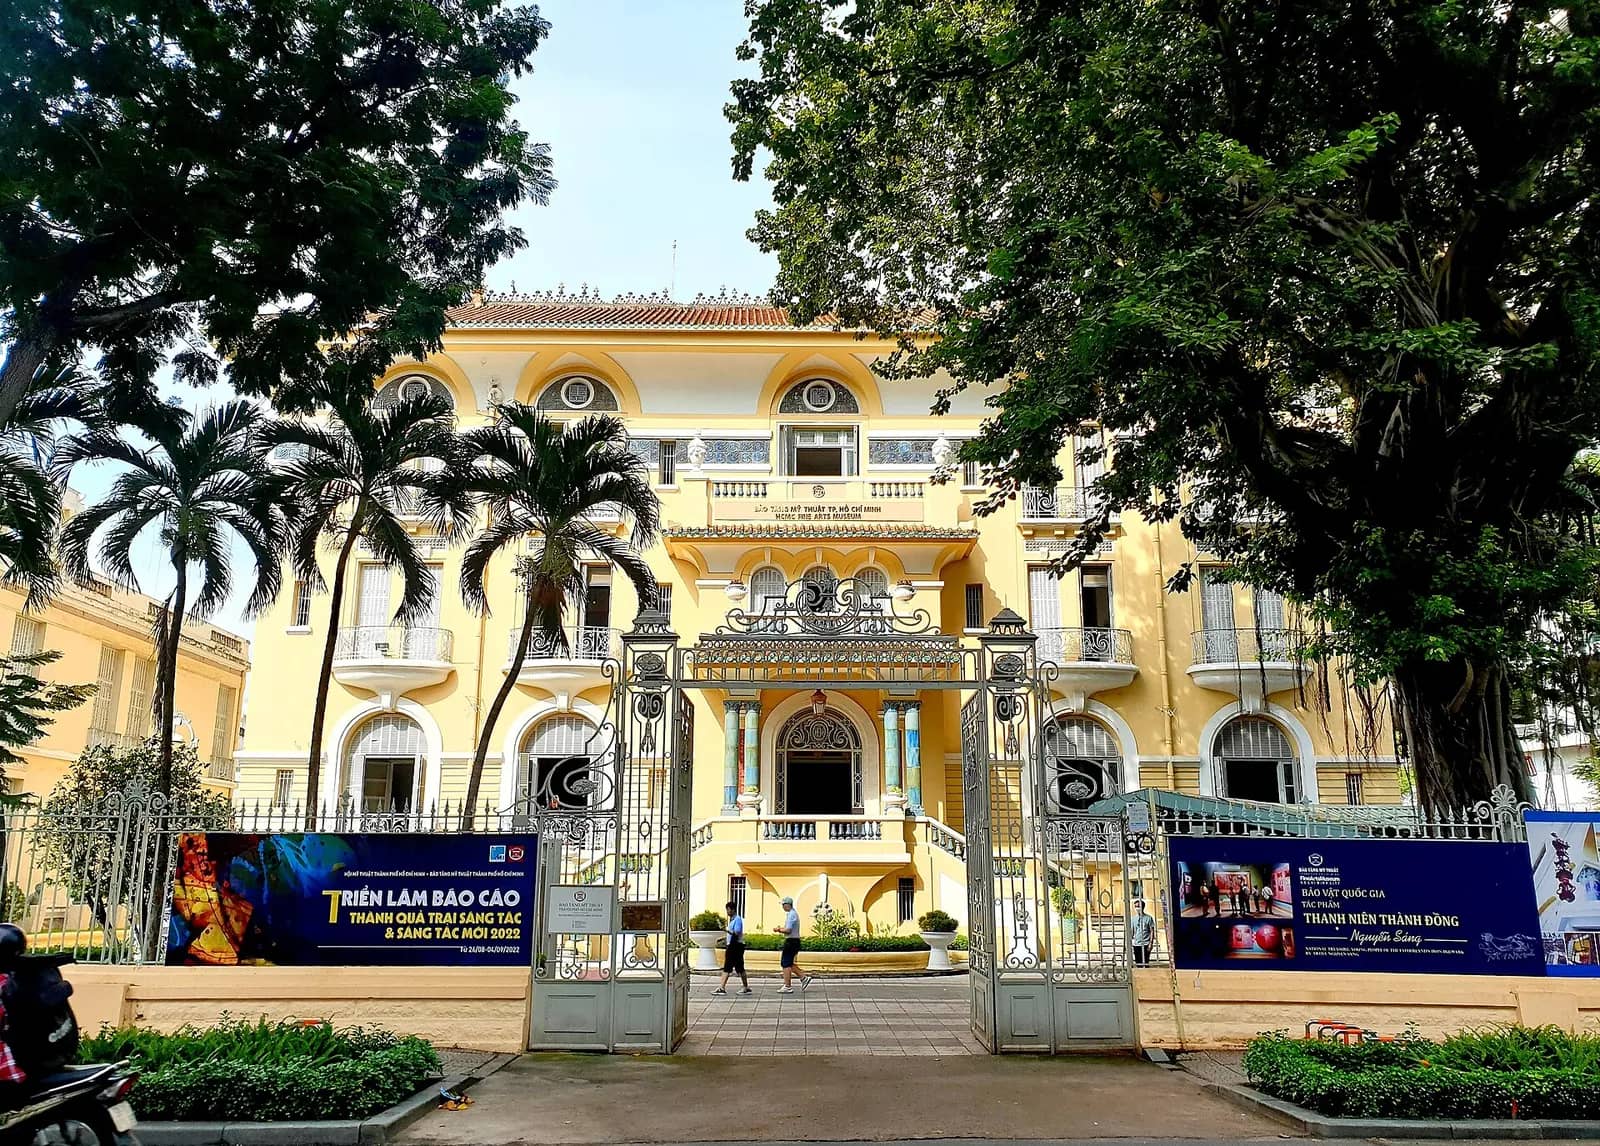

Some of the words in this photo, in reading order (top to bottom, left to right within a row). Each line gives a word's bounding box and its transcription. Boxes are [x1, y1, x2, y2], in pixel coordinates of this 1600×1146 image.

[1302, 886, 1320, 897] BẢO
[1322, 887, 1340, 899] VẬT
[1342, 888, 1367, 899] QUỐC
[1369, 889, 1386, 898] GIA
[322, 885, 383, 924] TRIỂN
[387, 888, 428, 907] LÃM
[432, 887, 475, 907] BÁO
[479, 887, 521, 907] CÁO
[1301, 900, 1316, 908] TÁC
[1318, 900, 1340, 908] PHẨM
[349, 910, 394, 924] THÀNH
[396, 909, 425, 924] QUẢ
[459, 911, 494, 924] SÁNG
[497, 911, 521, 924] TÁC
[1304, 913, 1346, 925] THANH
[1350, 912, 1377, 926] NIÊN
[1379, 912, 1422, 926] THÀNH
[1424, 912, 1460, 927] ĐỒNG
[384, 927, 395, 939] &
[397, 925, 432, 939] SÁNG
[435, 925, 459, 939] TÁC
[461, 926, 488, 939] MỚI
[490, 928, 520, 939] 2022
[1350, 929, 1392, 946] Nguyễn
[1393, 929, 1422, 946] Sáng
